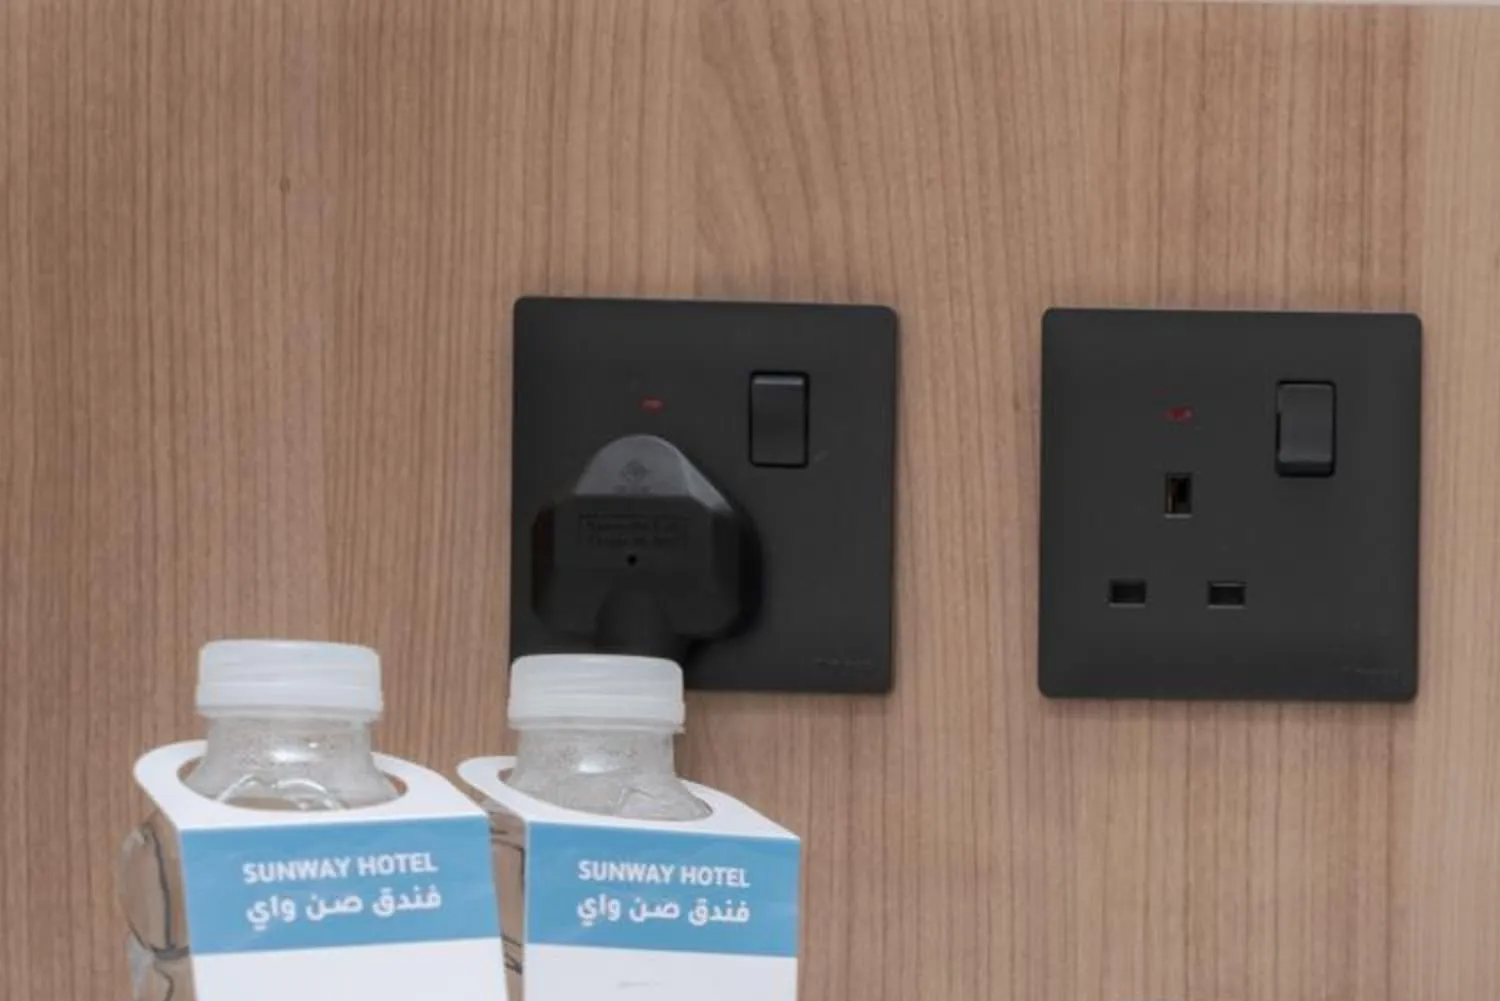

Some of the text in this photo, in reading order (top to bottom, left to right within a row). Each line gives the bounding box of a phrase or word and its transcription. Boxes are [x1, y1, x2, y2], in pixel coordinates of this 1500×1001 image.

[242, 852, 439, 884] SUNWAY HOTEL
[577, 860, 751, 888] SUNWAY HOTEL
[246, 884, 442, 931] فندق صن واي
[577, 892, 751, 928] فندق صن واي
